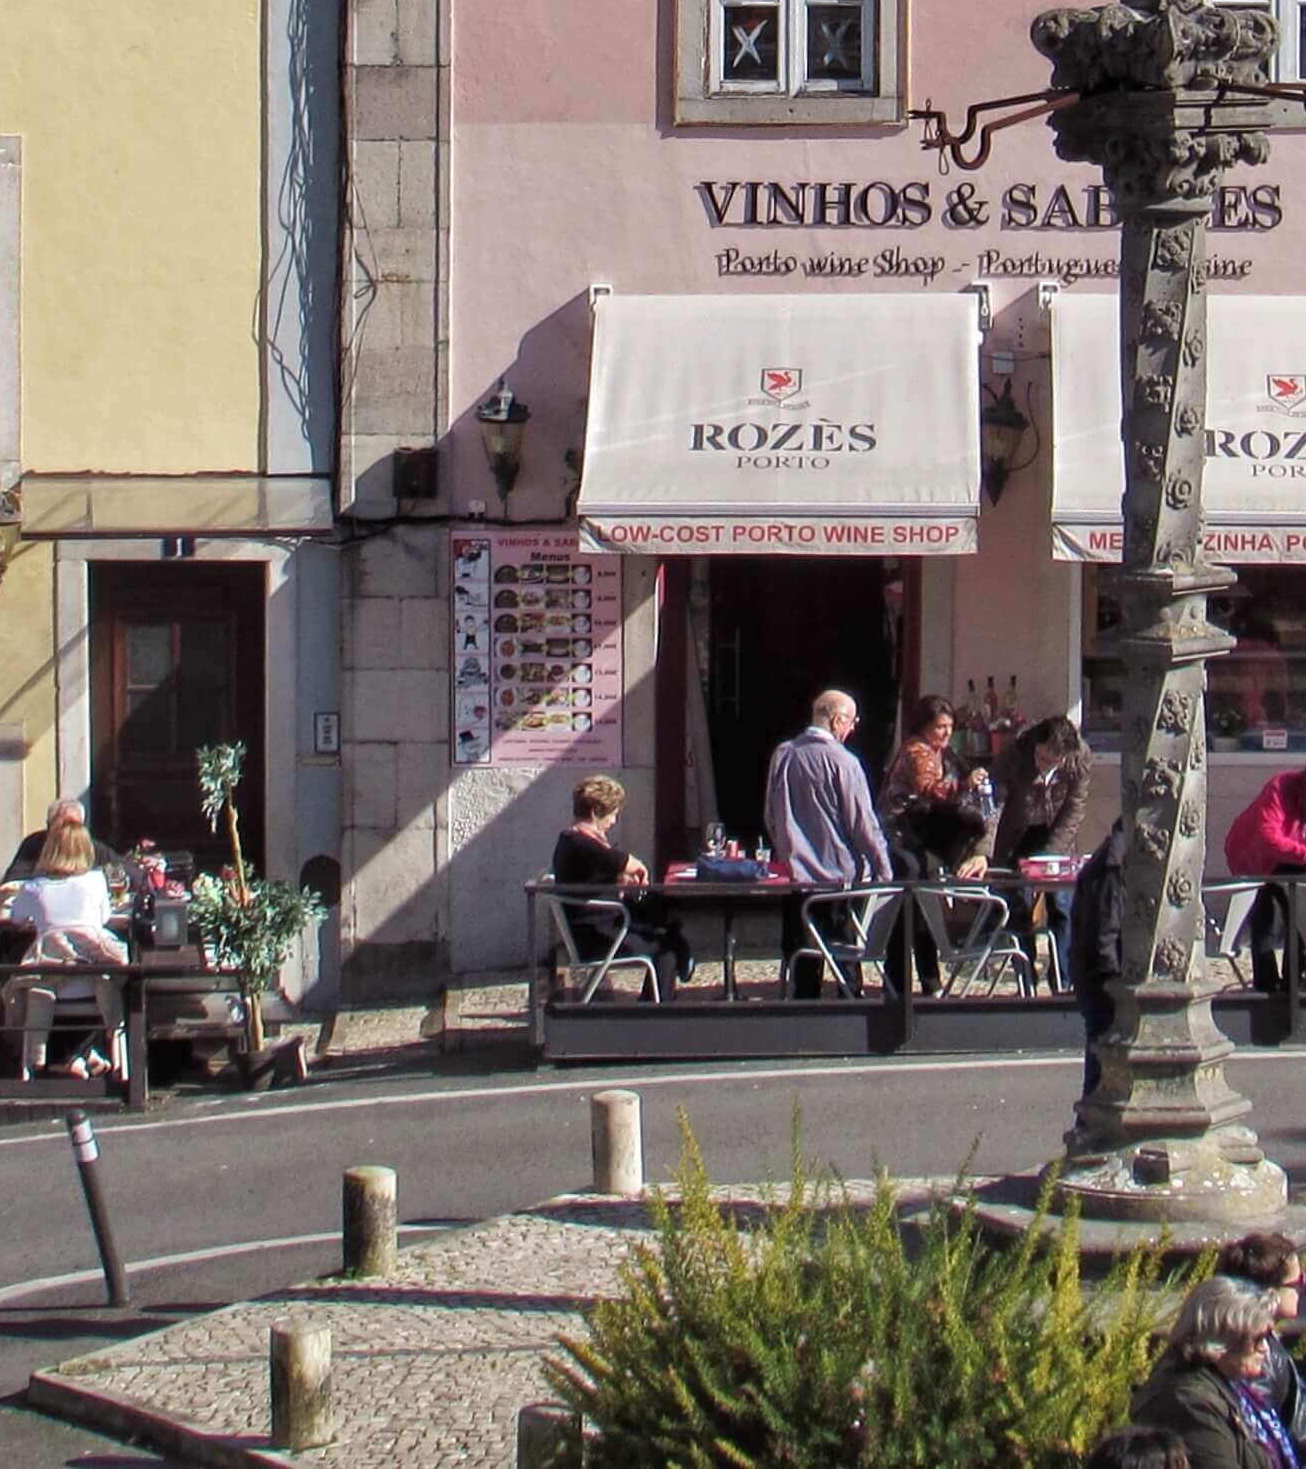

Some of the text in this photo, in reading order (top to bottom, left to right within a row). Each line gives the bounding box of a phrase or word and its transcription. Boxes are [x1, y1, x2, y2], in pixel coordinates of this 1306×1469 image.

[697, 181, 1282, 230] VINHOS & SABES
[718, 248, 797, 275] Porto
[803, 252, 869, 275] wine
[875, 246, 944, 284] Shop
[979, 249, 1121, 287] Portugue
[688, 418, 877, 452] ROZÈS
[736, 456, 830, 470] PORTO
[597, 524, 724, 544] LOW-COST
[732, 524, 815, 544] PORTO
[823, 524, 884, 544] WINE
[892, 524, 959, 544] SHOP
[1089, 532, 1123, 550] ME
[1203, 533, 1274, 551] ZINHA
[530, 551, 570, 561] Menus
